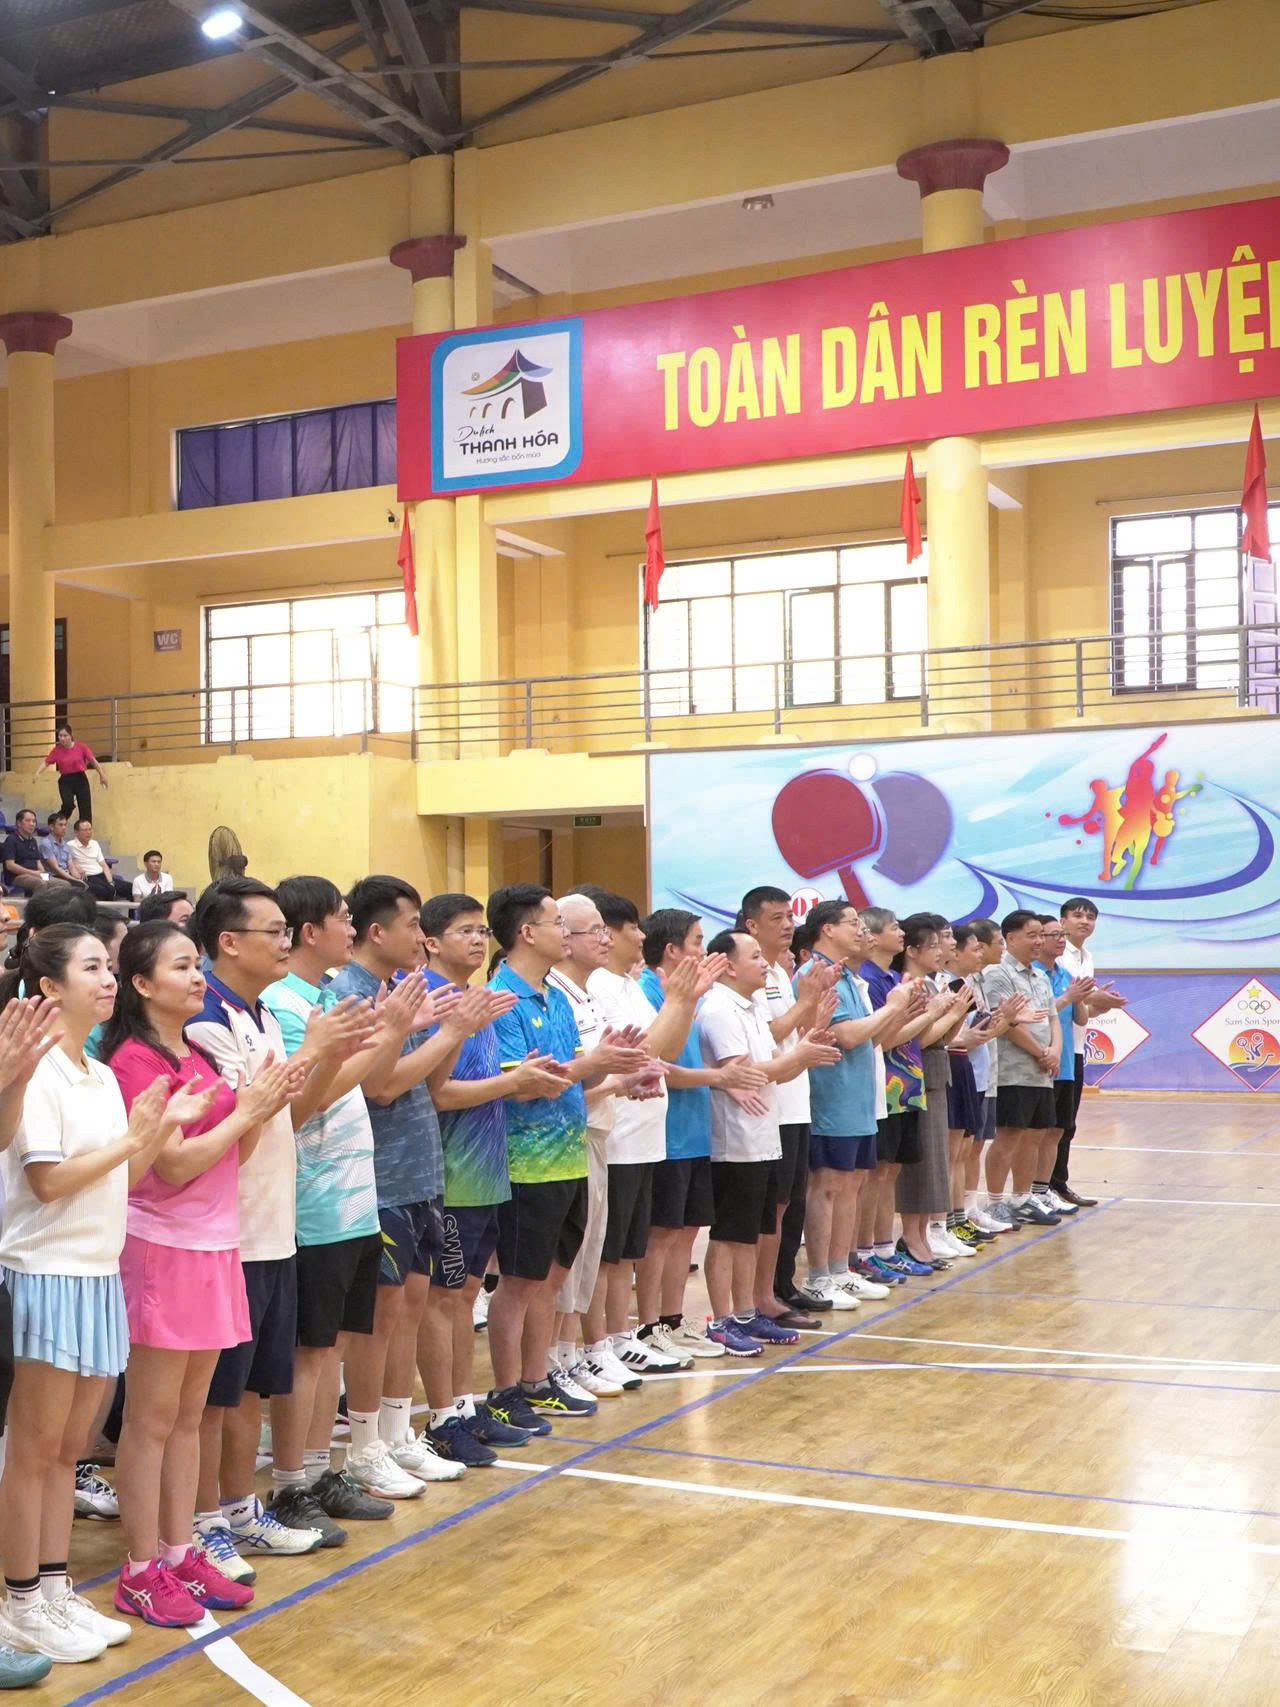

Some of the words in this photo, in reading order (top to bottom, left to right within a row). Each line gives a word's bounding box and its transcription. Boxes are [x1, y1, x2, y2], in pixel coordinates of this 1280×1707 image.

[656, 324, 801, 431] TOÀN
[821, 301, 943, 410] DÂN
[963, 279, 1087, 389] RÈN
[1108, 244, 1280, 374] LUYỆ
[453, 425, 478, 442] Du
[460, 437, 517, 455] THANH
[523, 430, 559, 449] HÓA
[157, 632, 178, 646] WC
[1262, 1016, 1280, 1028] Spor
[442, 1213, 466, 1287] SWIN
